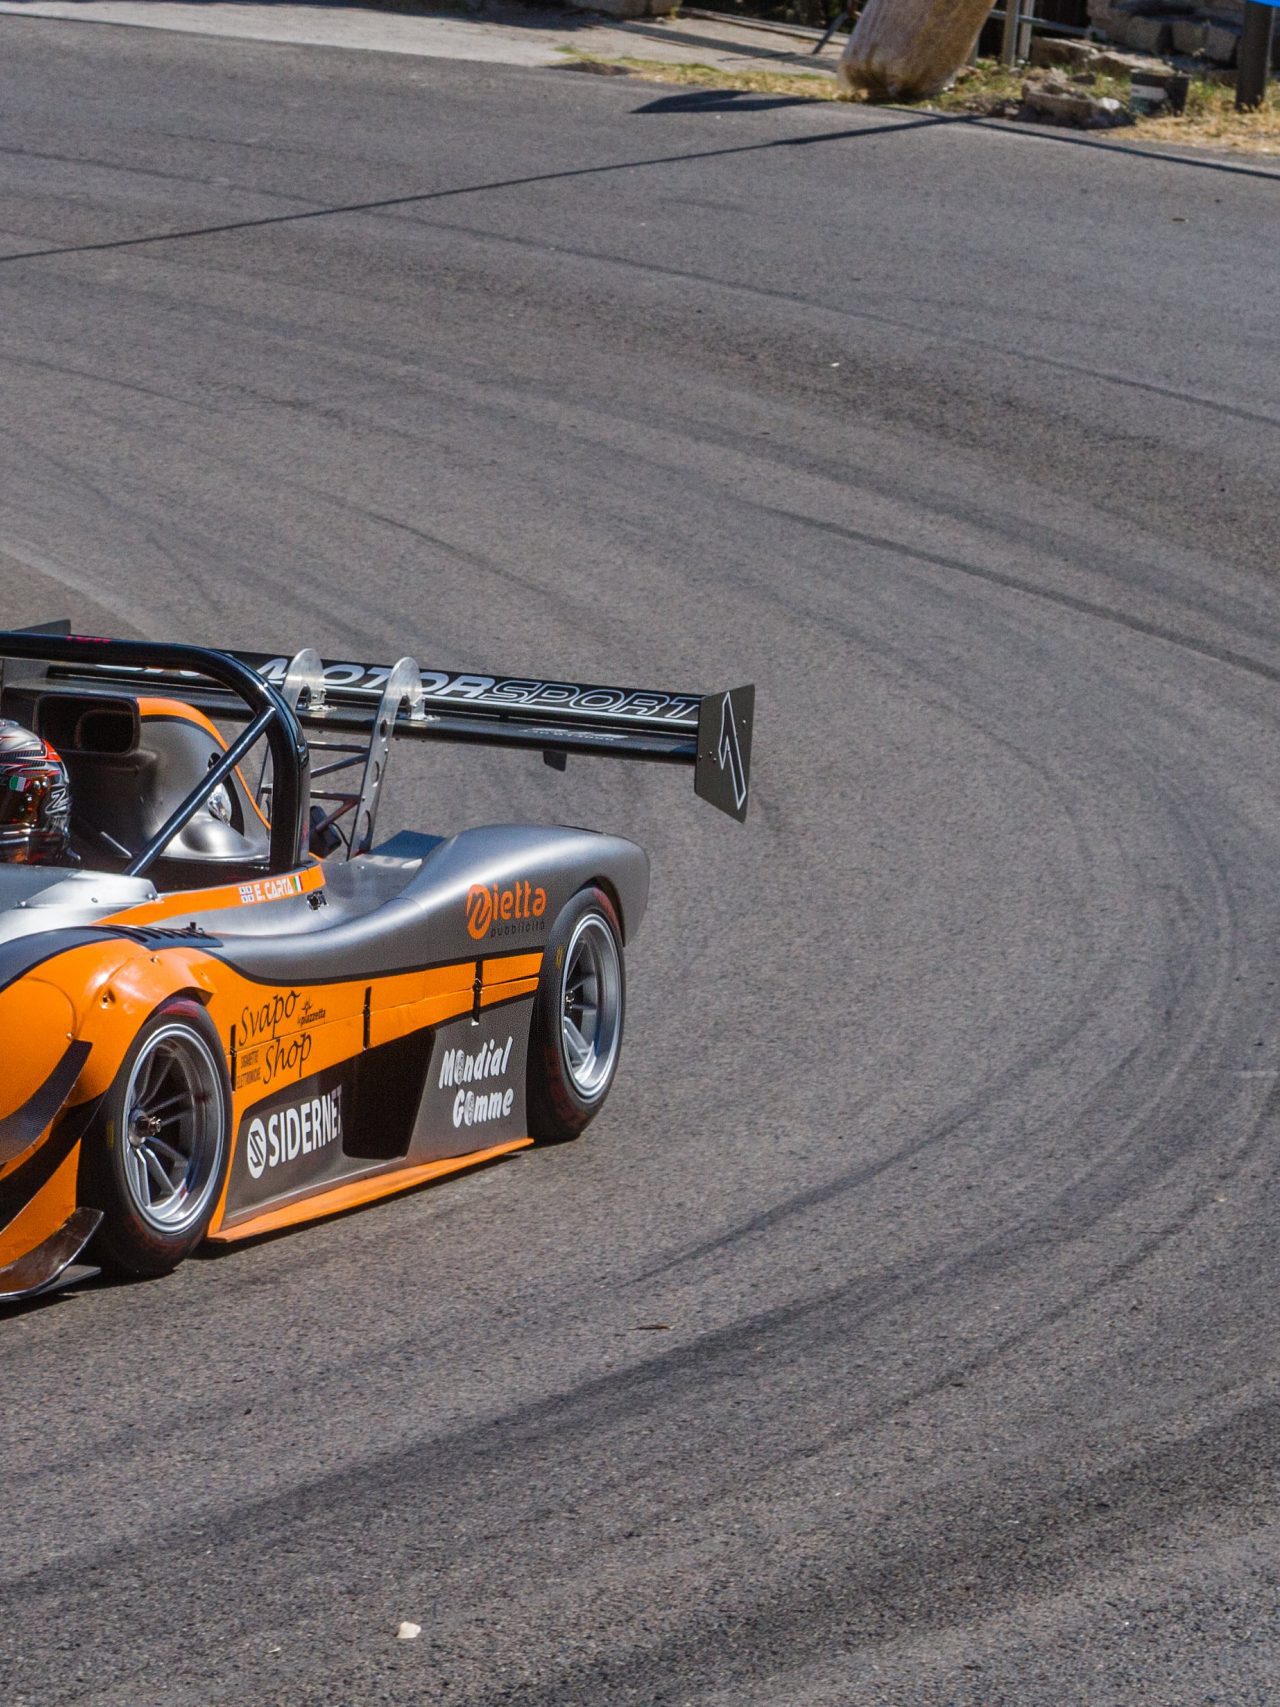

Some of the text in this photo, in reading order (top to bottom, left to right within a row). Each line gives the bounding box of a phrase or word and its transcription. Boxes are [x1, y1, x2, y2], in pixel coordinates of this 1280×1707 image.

[264, 878, 294, 899] CARTA
[438, 1036, 513, 1089] Mondial
[452, 1088, 514, 1128] Gomme
